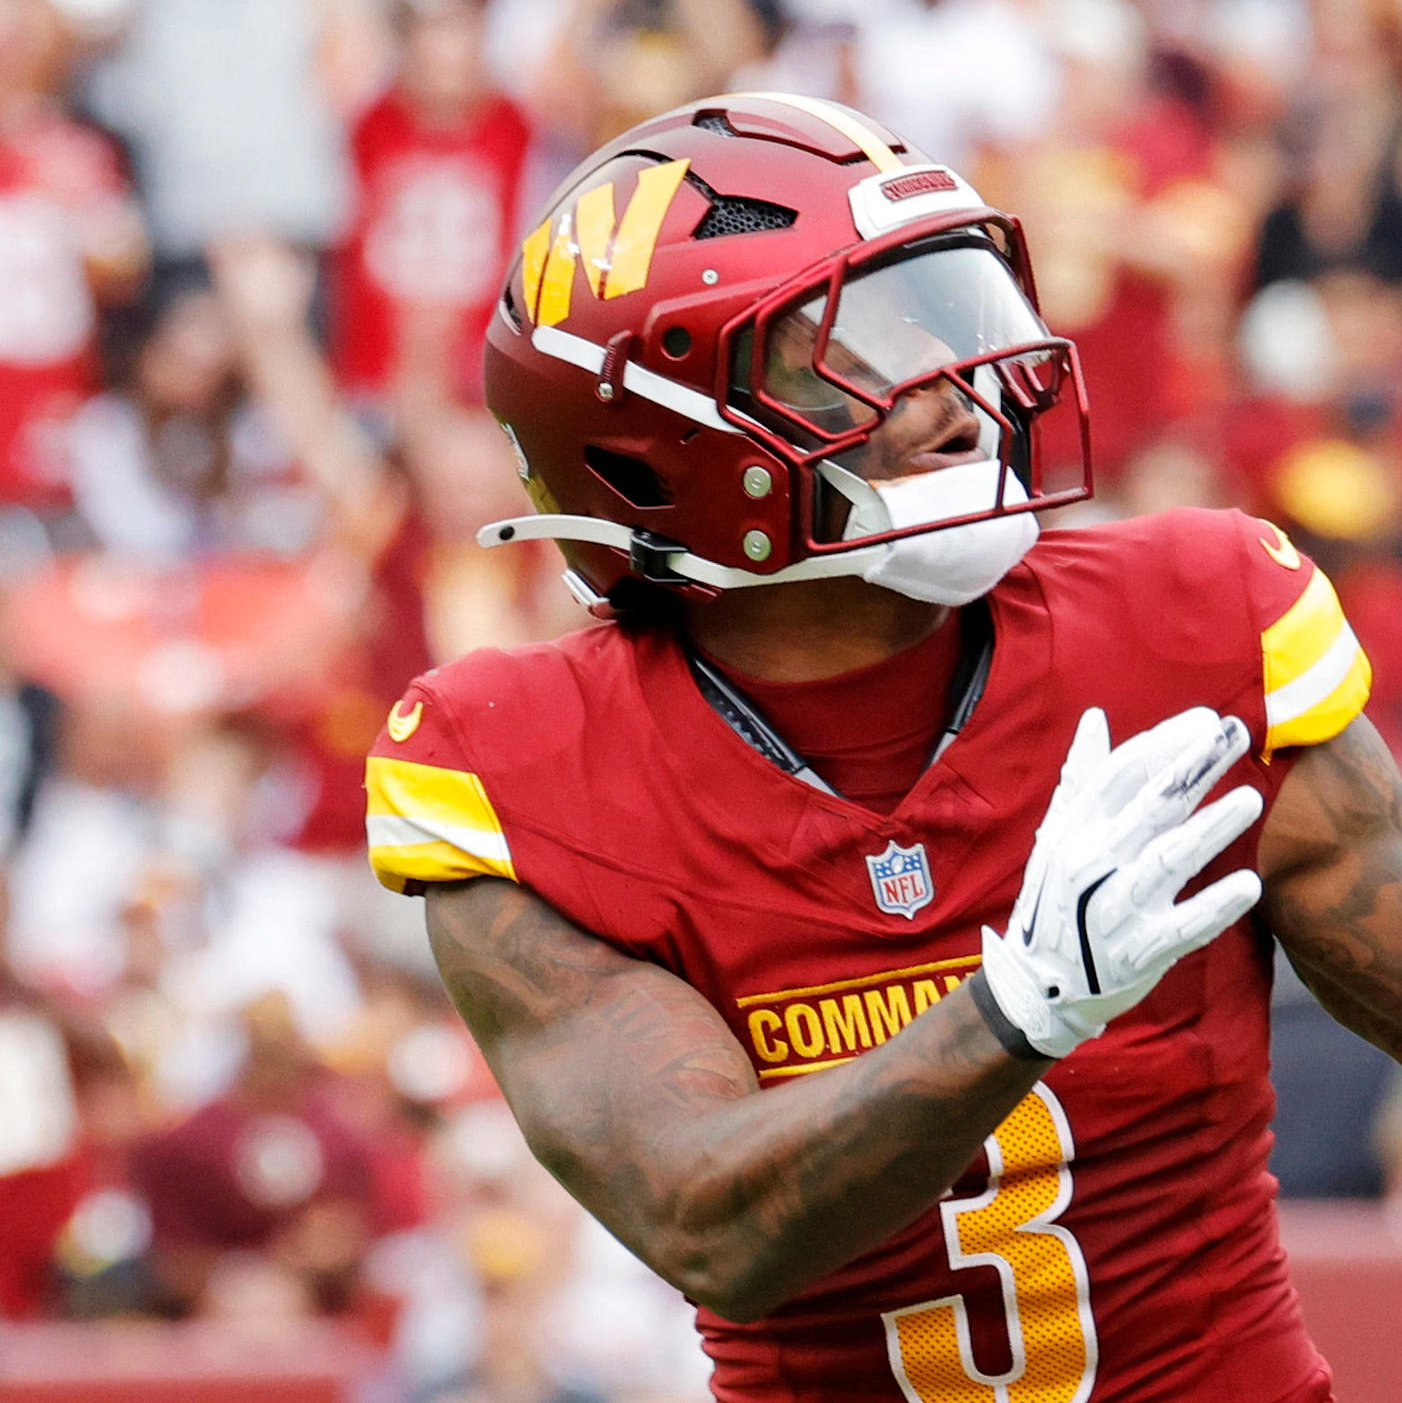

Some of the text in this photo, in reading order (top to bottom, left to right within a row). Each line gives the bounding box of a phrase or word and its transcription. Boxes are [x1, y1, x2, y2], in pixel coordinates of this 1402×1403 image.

[883, 875, 924, 905] NFL
[748, 973, 976, 1063] COMMA
[880, 1079, 1099, 1403] 3
